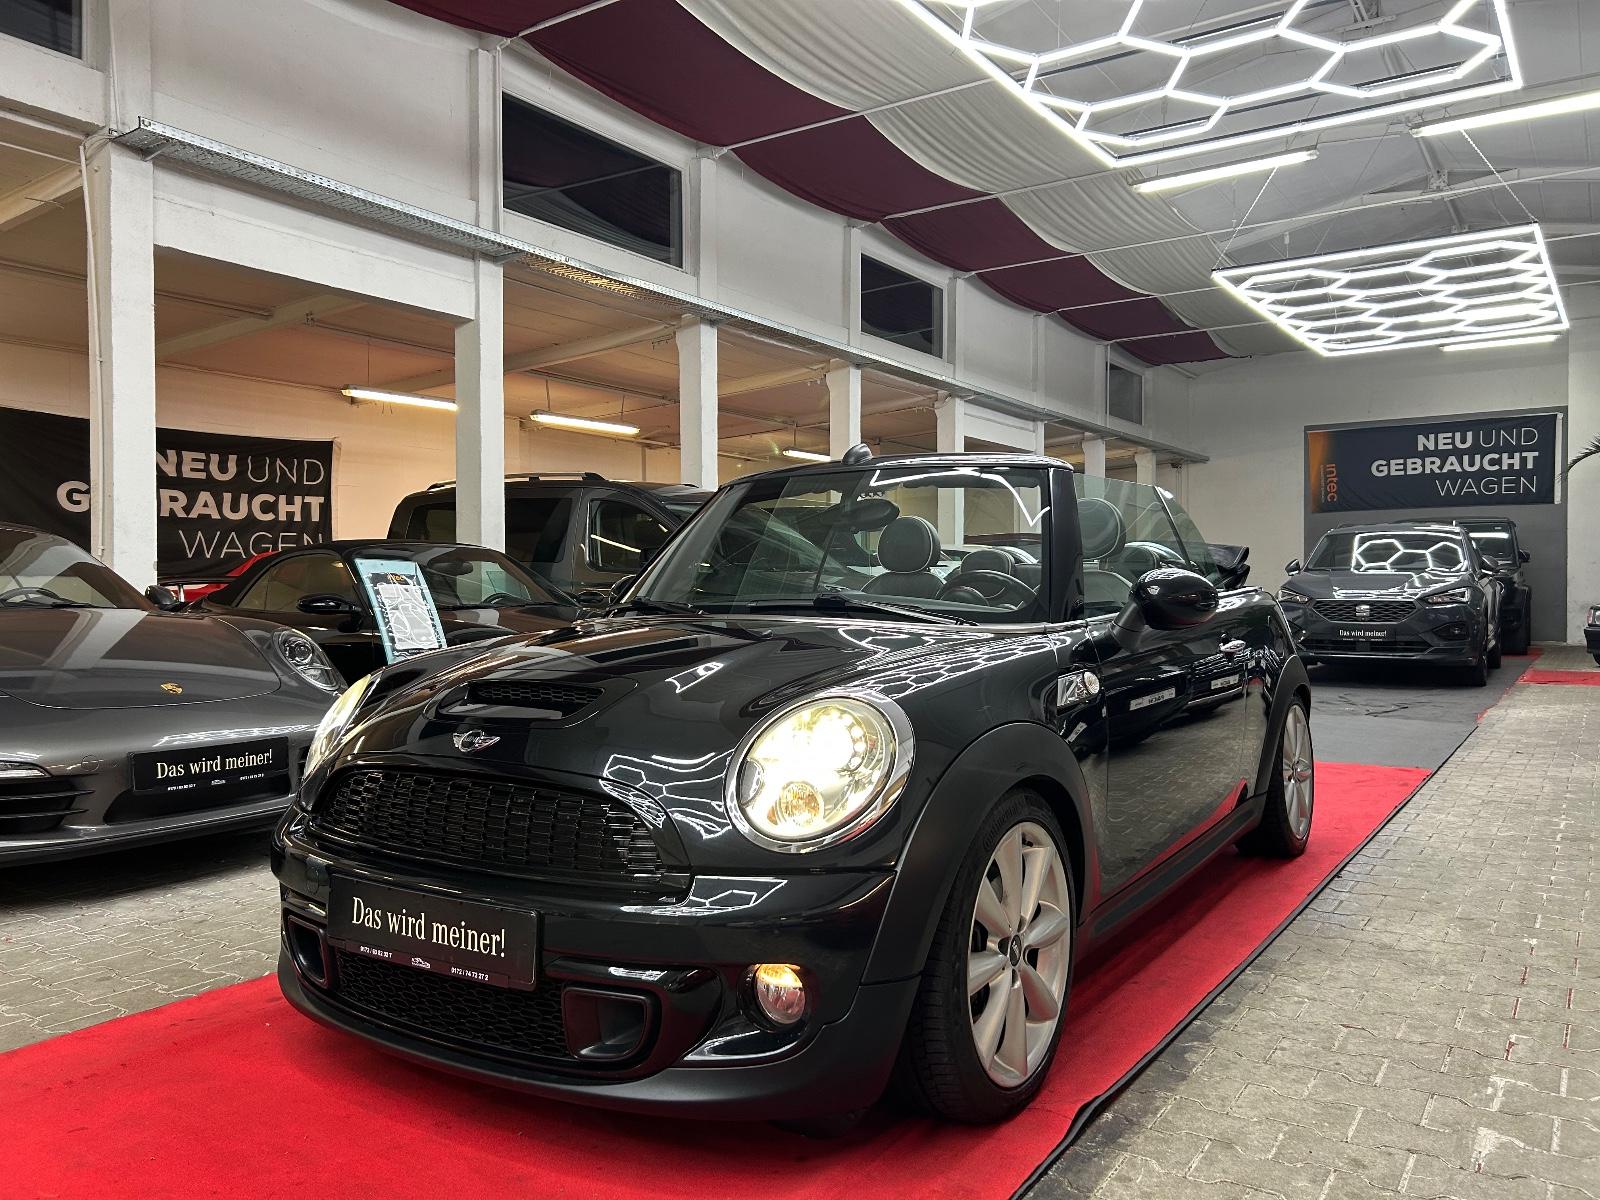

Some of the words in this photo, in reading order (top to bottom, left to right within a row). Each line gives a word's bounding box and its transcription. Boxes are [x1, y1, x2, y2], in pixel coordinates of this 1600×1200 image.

[1417, 430, 1473, 451] NEU
[1479, 427, 1539, 447] UND
[155, 449, 238, 481] NEU
[247, 455, 325, 485] UND
[1370, 451, 1539, 477] GEBRAUCHT
[1326, 463, 1338, 502] intec
[1435, 475, 1537, 496] WAGEN
[56, 480, 325, 522] GRAUCHT
[1350, 629, 1364, 637] wird
[156, 762, 185, 779] Das
[189, 755, 221, 775] wird
[225, 748, 273, 770] meiner!
[352, 896, 382, 930] Das
[387, 909, 426, 941] wird
[431, 920, 506, 958] meiner!
